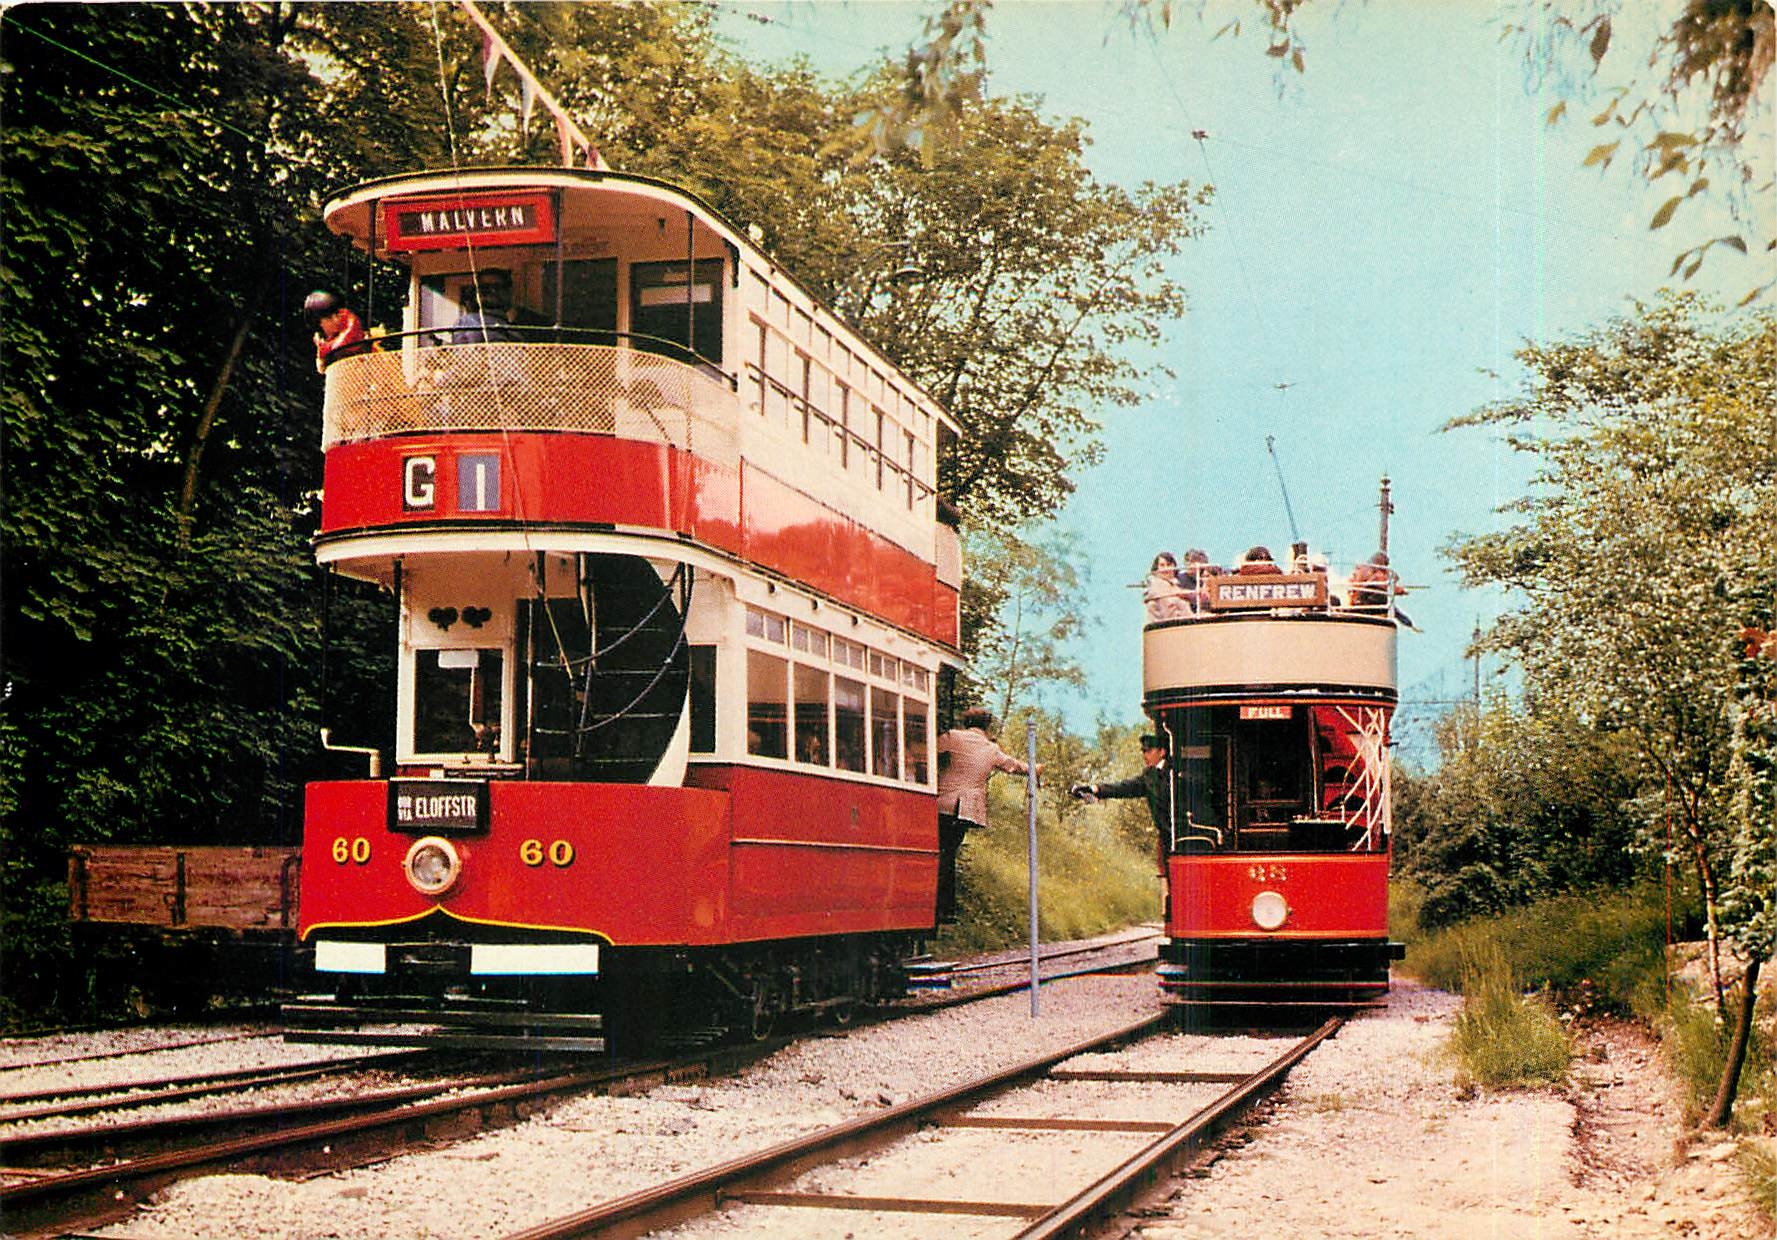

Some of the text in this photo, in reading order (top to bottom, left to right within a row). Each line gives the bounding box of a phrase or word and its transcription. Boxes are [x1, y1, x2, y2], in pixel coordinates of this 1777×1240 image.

[420, 206, 525, 232] MALVERN
[405, 457, 436, 506] G
[1220, 583, 1316, 600] RENFREW
[1248, 707, 1284, 719] FULL
[332, 837, 370, 863] 60
[520, 839, 574, 865] 60
